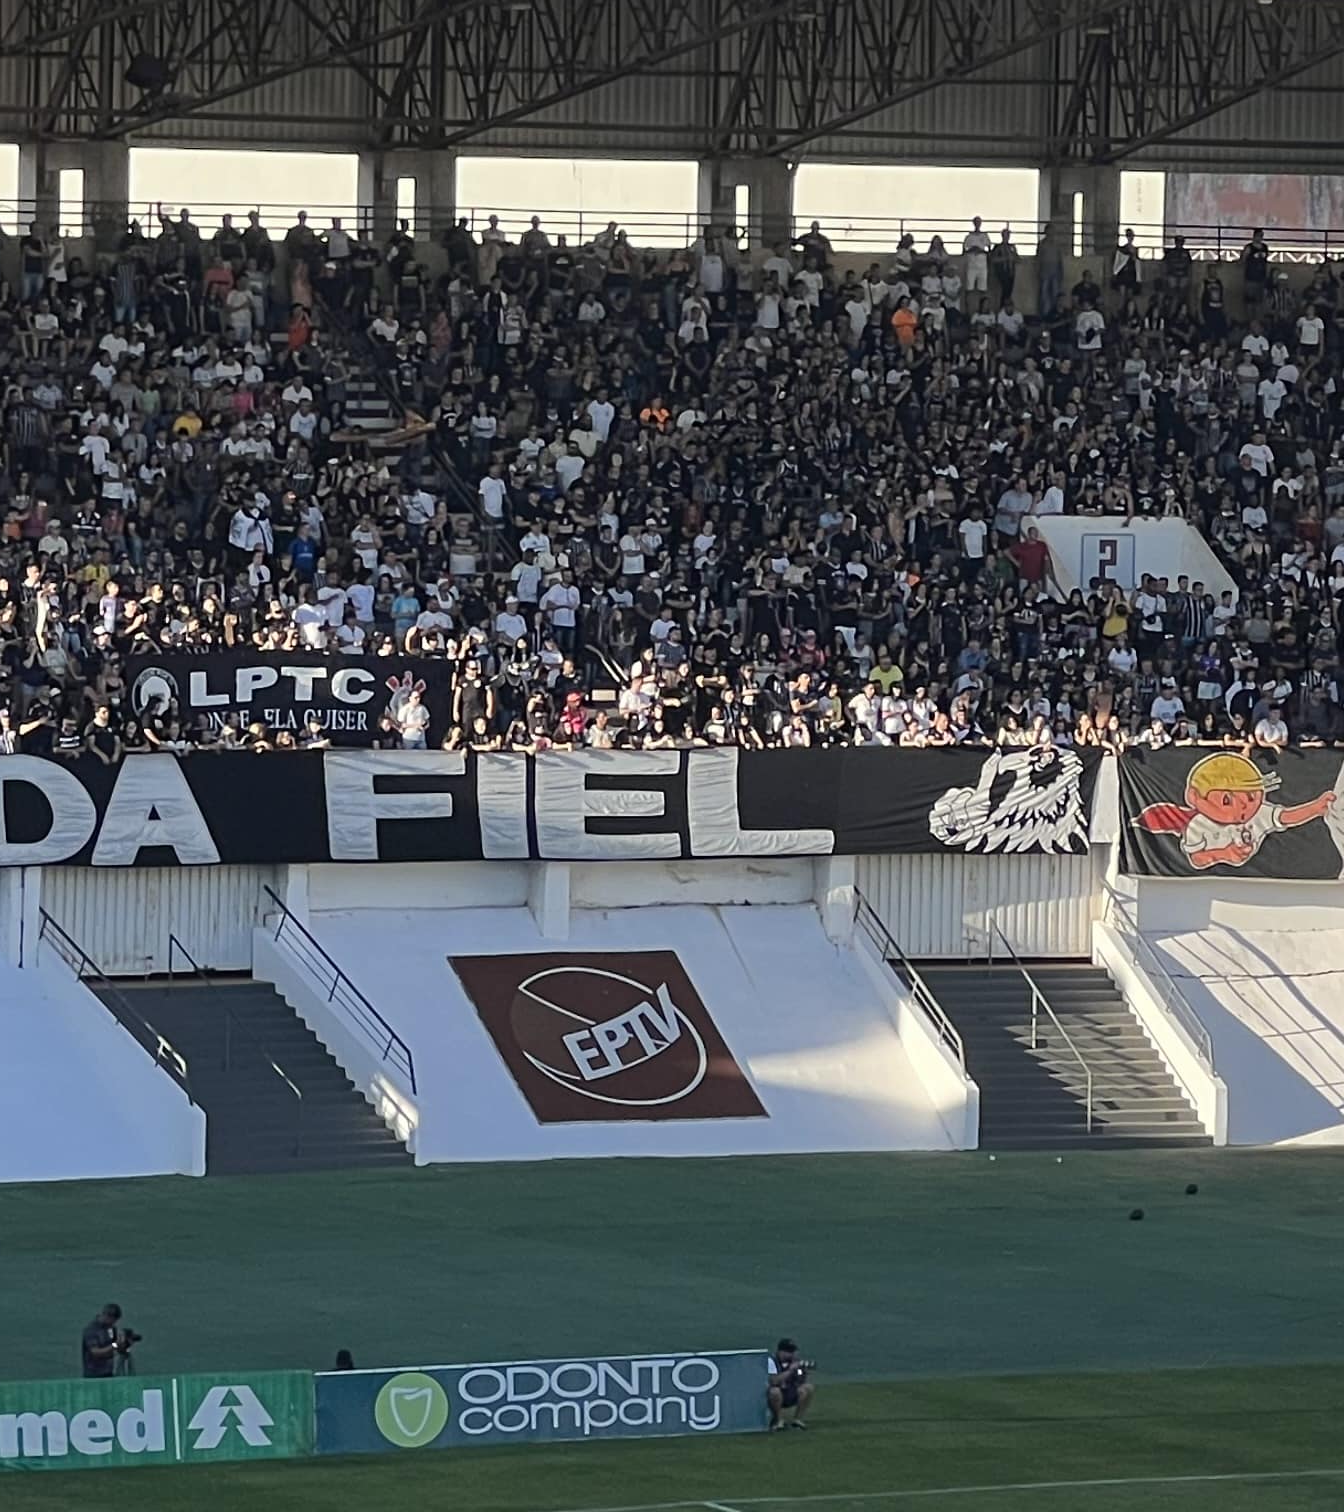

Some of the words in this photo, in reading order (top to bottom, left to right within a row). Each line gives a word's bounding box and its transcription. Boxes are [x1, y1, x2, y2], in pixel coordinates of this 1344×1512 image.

[1099, 539, 1117, 584] 2
[190, 666, 375, 707] LPTC
[323, 748, 835, 860] FIEL
[562, 982, 681, 1081] EPTV
[458, 1357, 720, 1404] ODONTO
[459, 1395, 720, 1435] company
